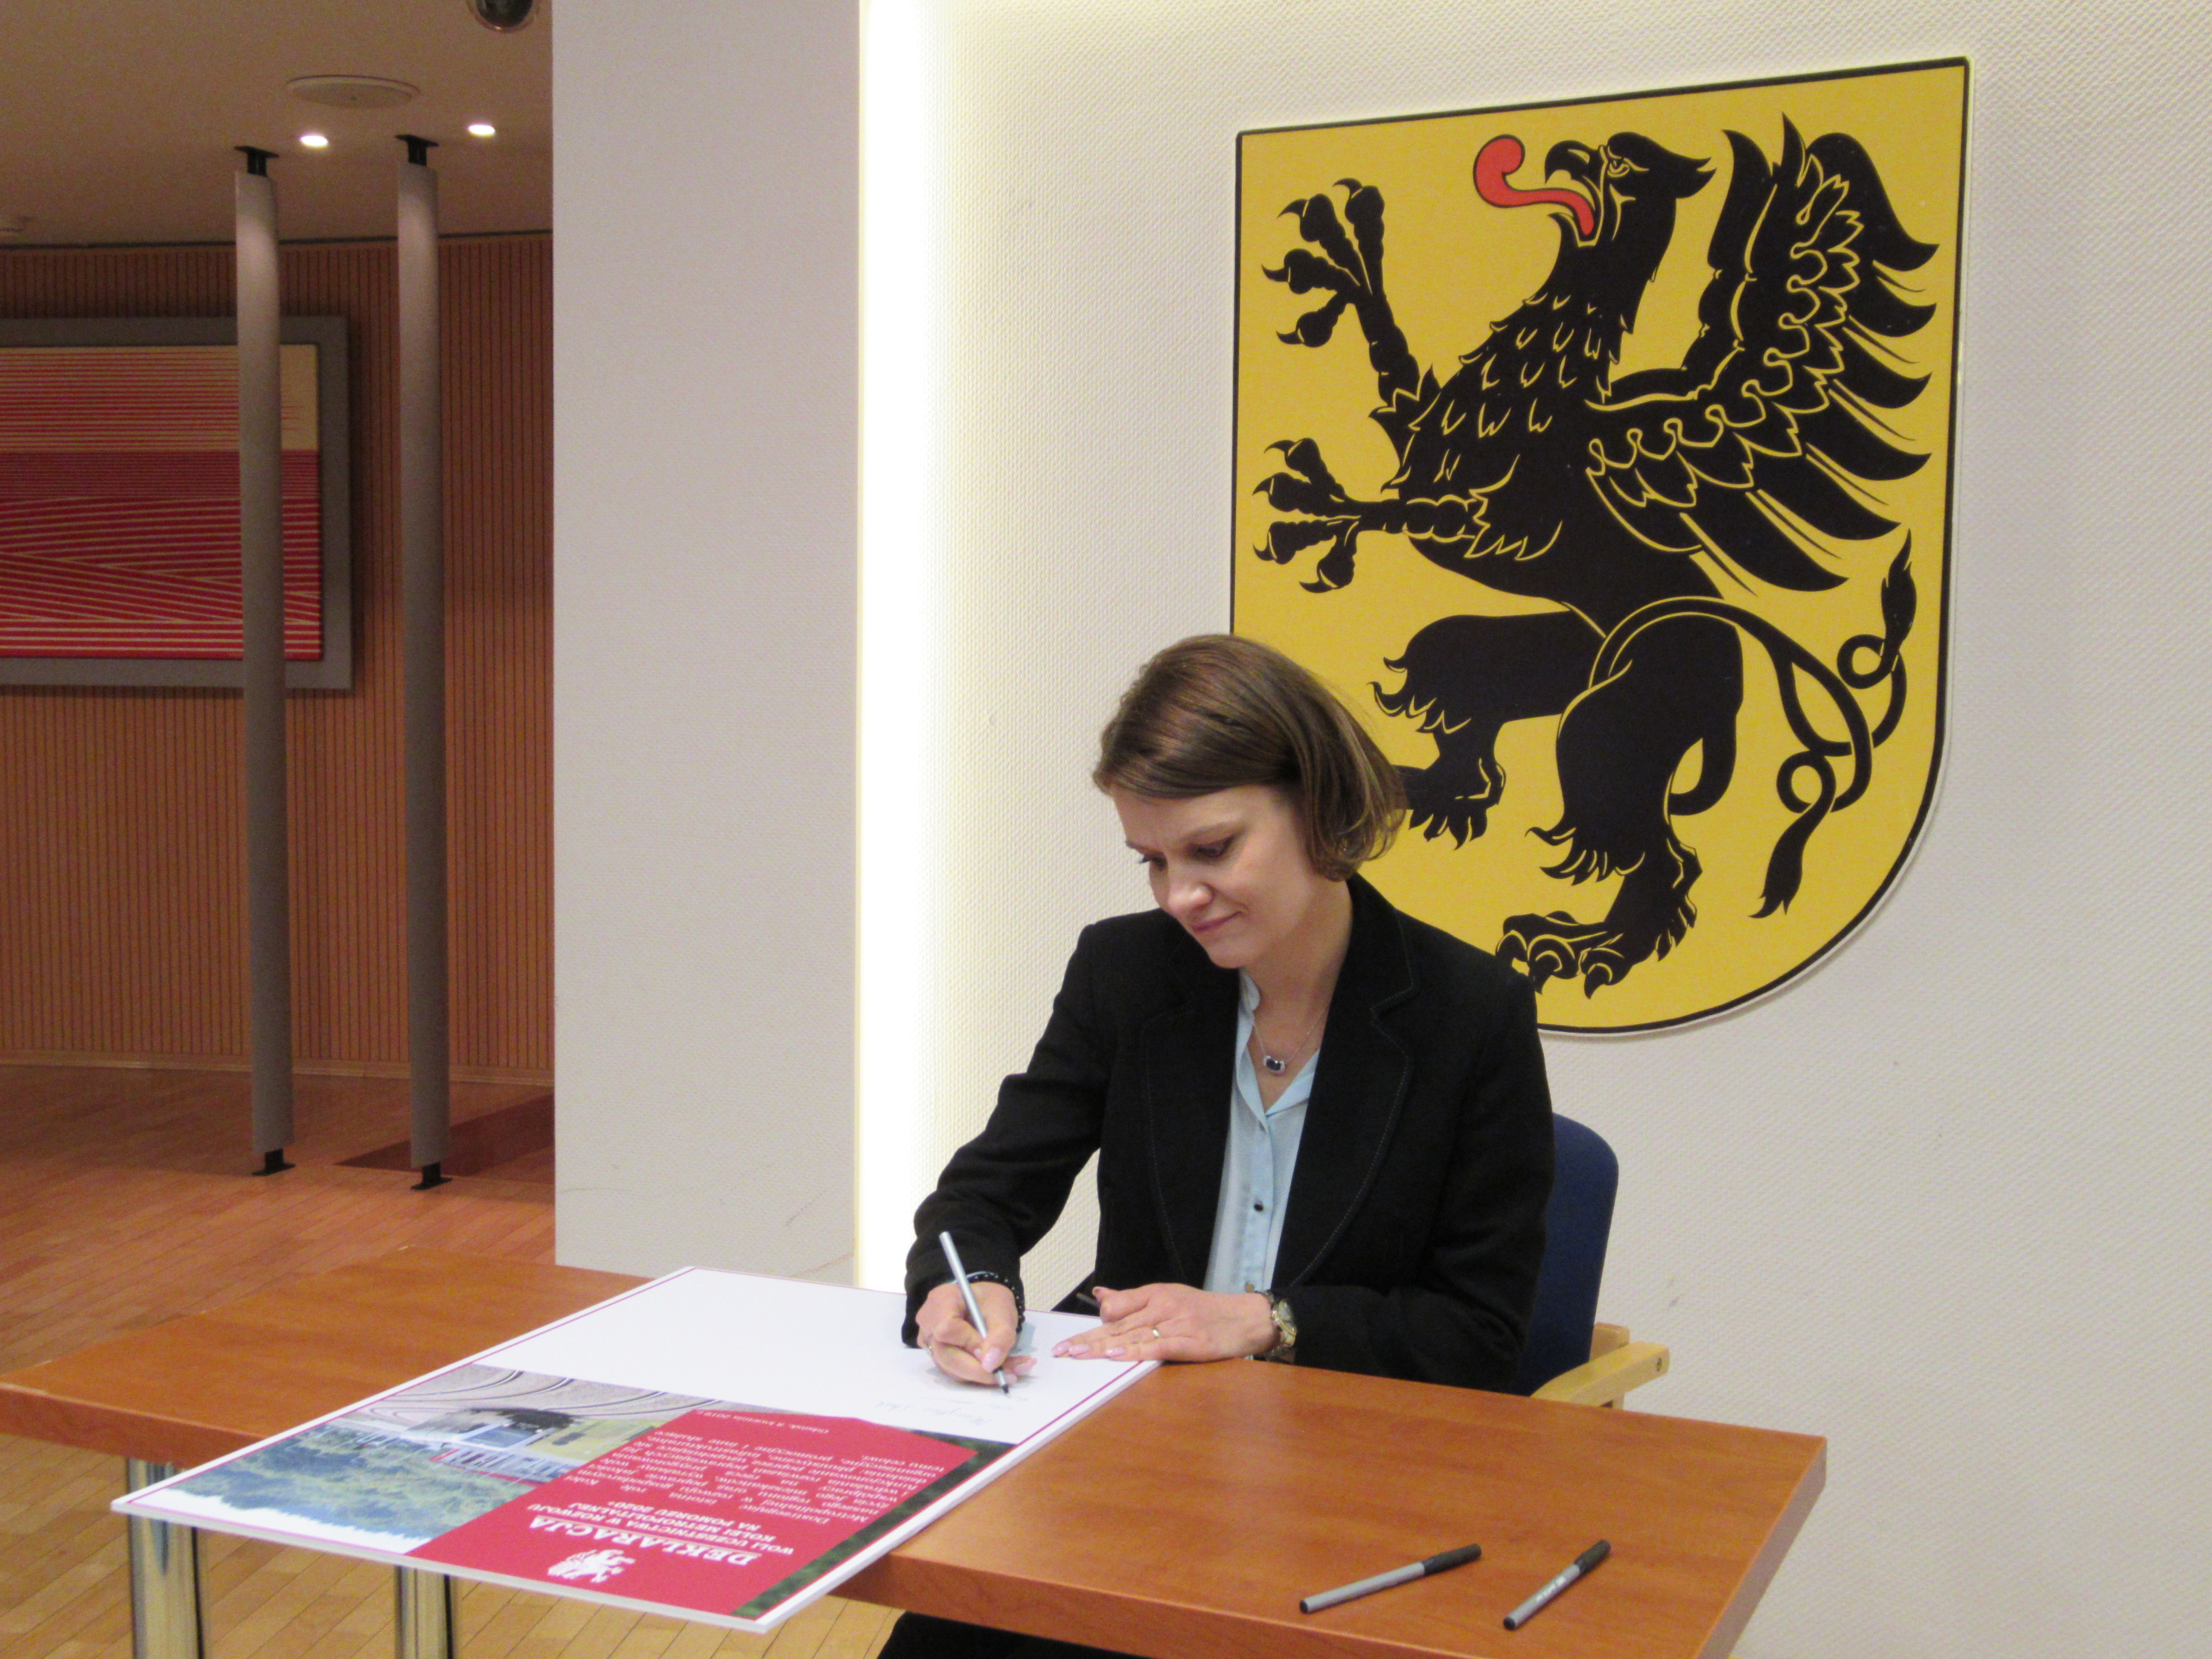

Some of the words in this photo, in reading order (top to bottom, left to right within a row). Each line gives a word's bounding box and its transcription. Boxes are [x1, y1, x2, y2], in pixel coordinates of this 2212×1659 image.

[526, 1503, 605, 1521] ROZWOJU
[569, 1502, 720, 1532] METROPOLITALNEJ
[655, 1508, 735, 1526] POMORZU
[627, 1520, 748, 1546] UCZESTNICTWA
[724, 1529, 777, 1542] KOLEI
[738, 1522, 762, 1531] NA
[529, 1516, 761, 1566] DEKLARACJA
[751, 1543, 795, 1555] WOLI
